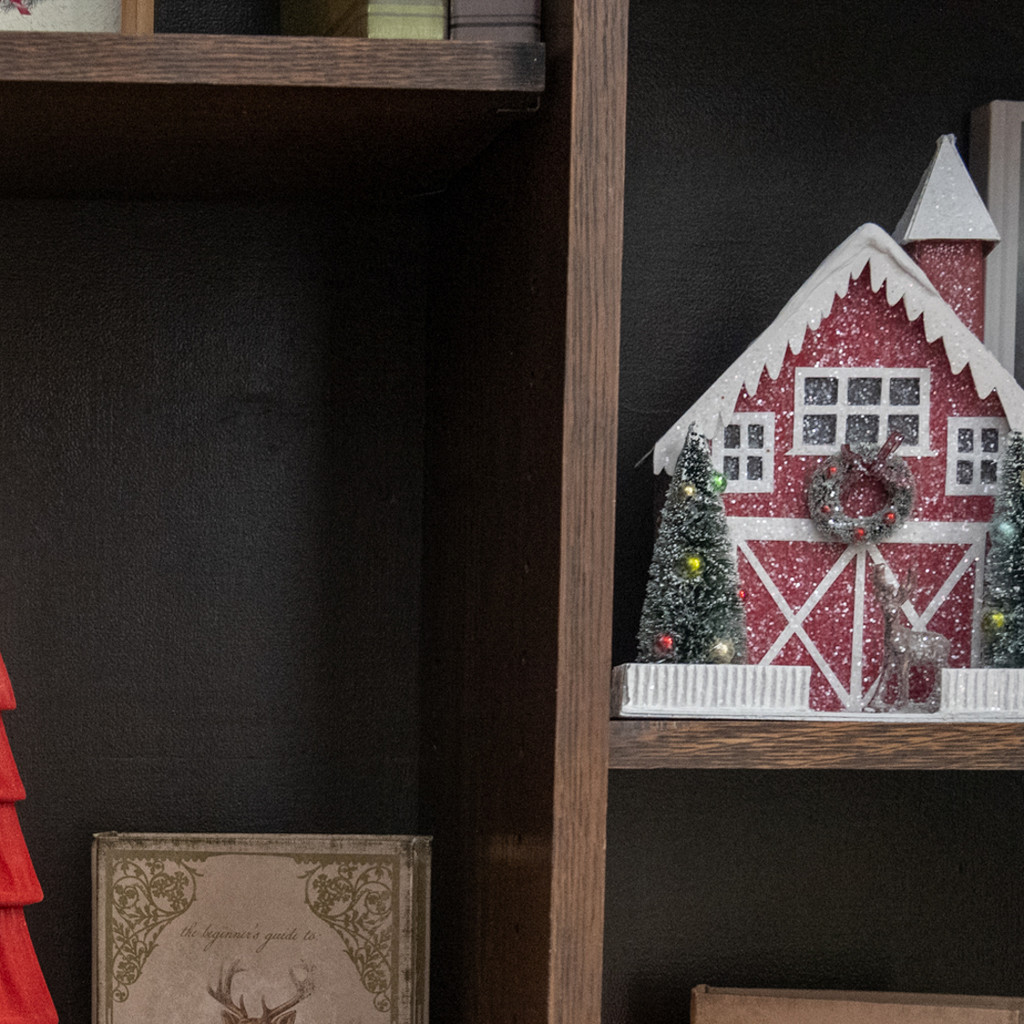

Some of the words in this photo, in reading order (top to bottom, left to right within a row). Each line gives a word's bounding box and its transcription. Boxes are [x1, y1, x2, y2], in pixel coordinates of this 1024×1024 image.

[180, 922, 197, 938] the
[202, 923, 259, 951] beginner's
[255, 928, 298, 953] guide
